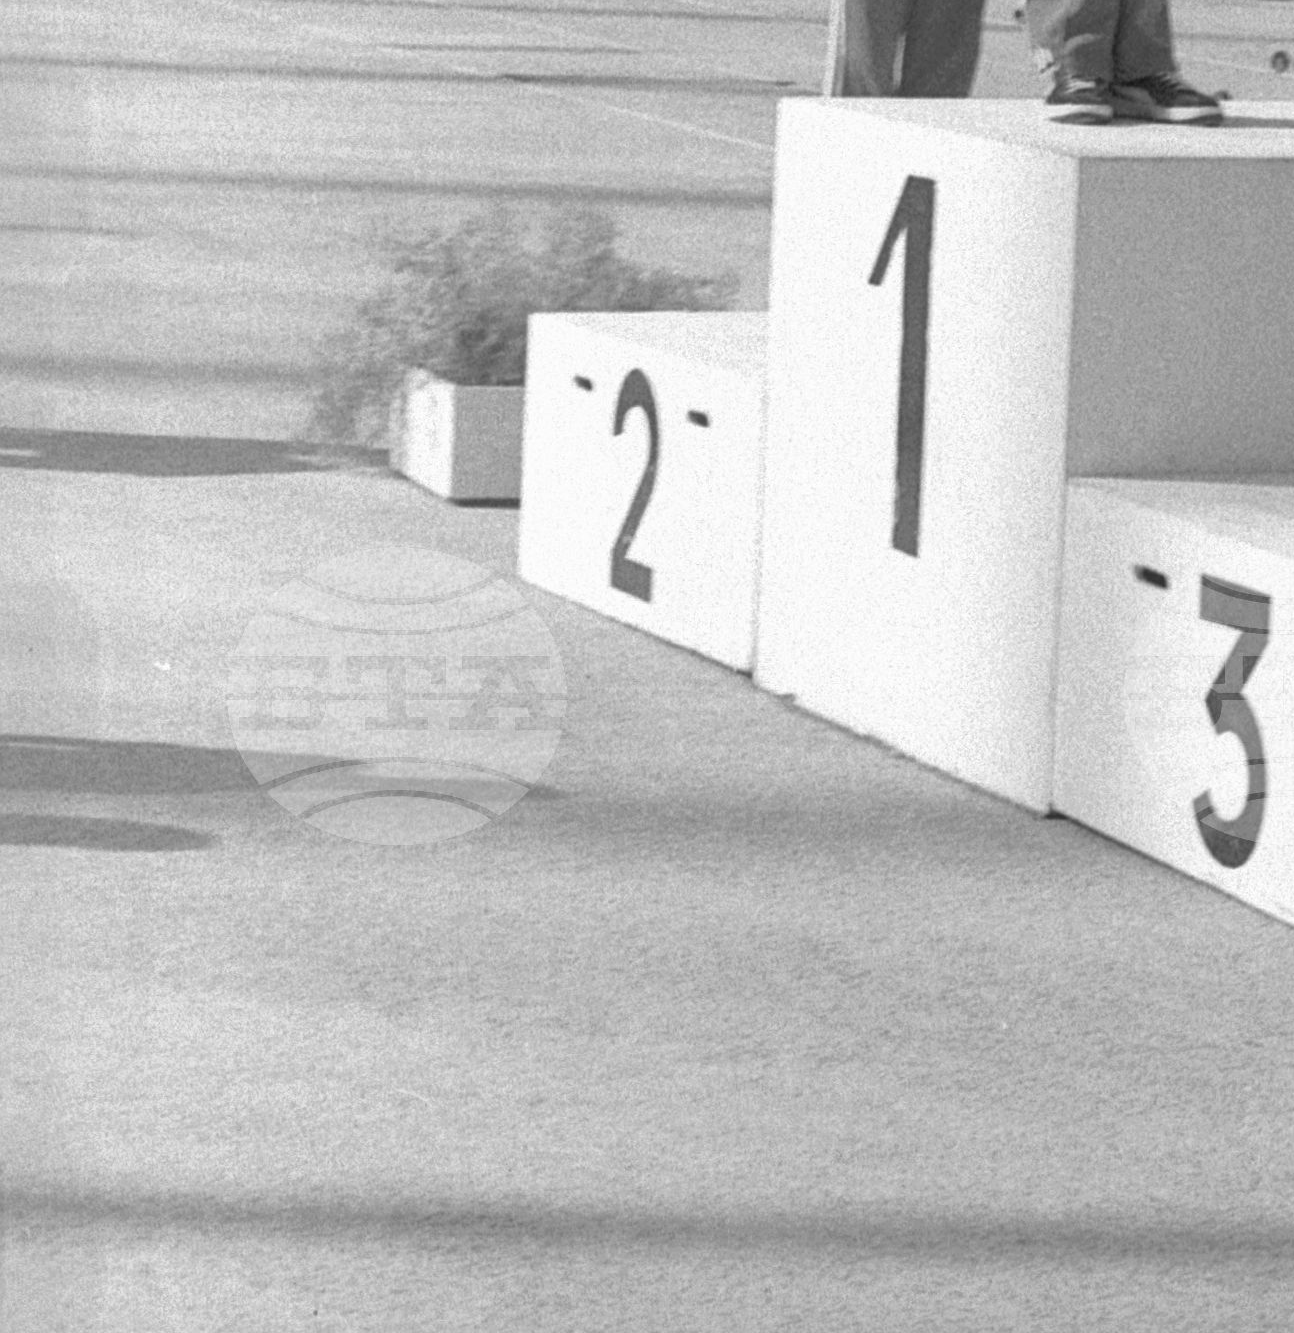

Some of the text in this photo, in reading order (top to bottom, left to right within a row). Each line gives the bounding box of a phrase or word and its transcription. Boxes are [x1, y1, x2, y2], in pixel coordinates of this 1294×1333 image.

[609, 368, 660, 604] 2
[868, 174, 936, 558] 1
[1192, 572, 1272, 869] 3
